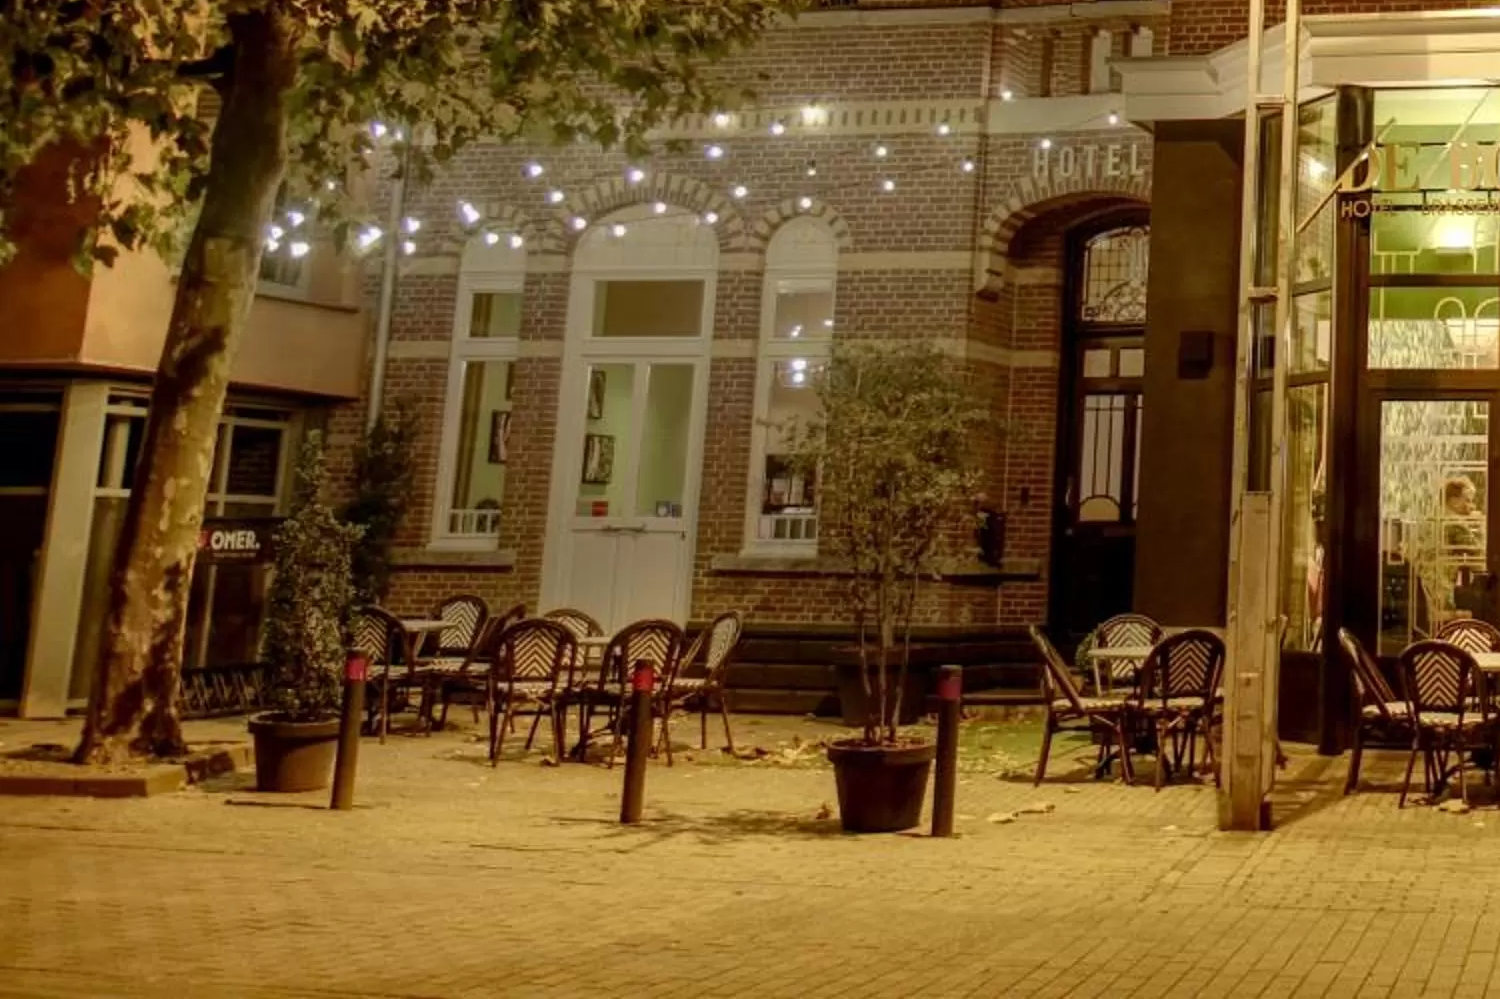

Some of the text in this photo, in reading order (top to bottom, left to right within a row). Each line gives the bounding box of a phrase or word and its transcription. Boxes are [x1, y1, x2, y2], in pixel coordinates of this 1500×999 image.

[1034, 145, 1144, 178] HOTEL
[1338, 143, 1420, 193] DE
[1341, 199, 1396, 218] HOTEL
